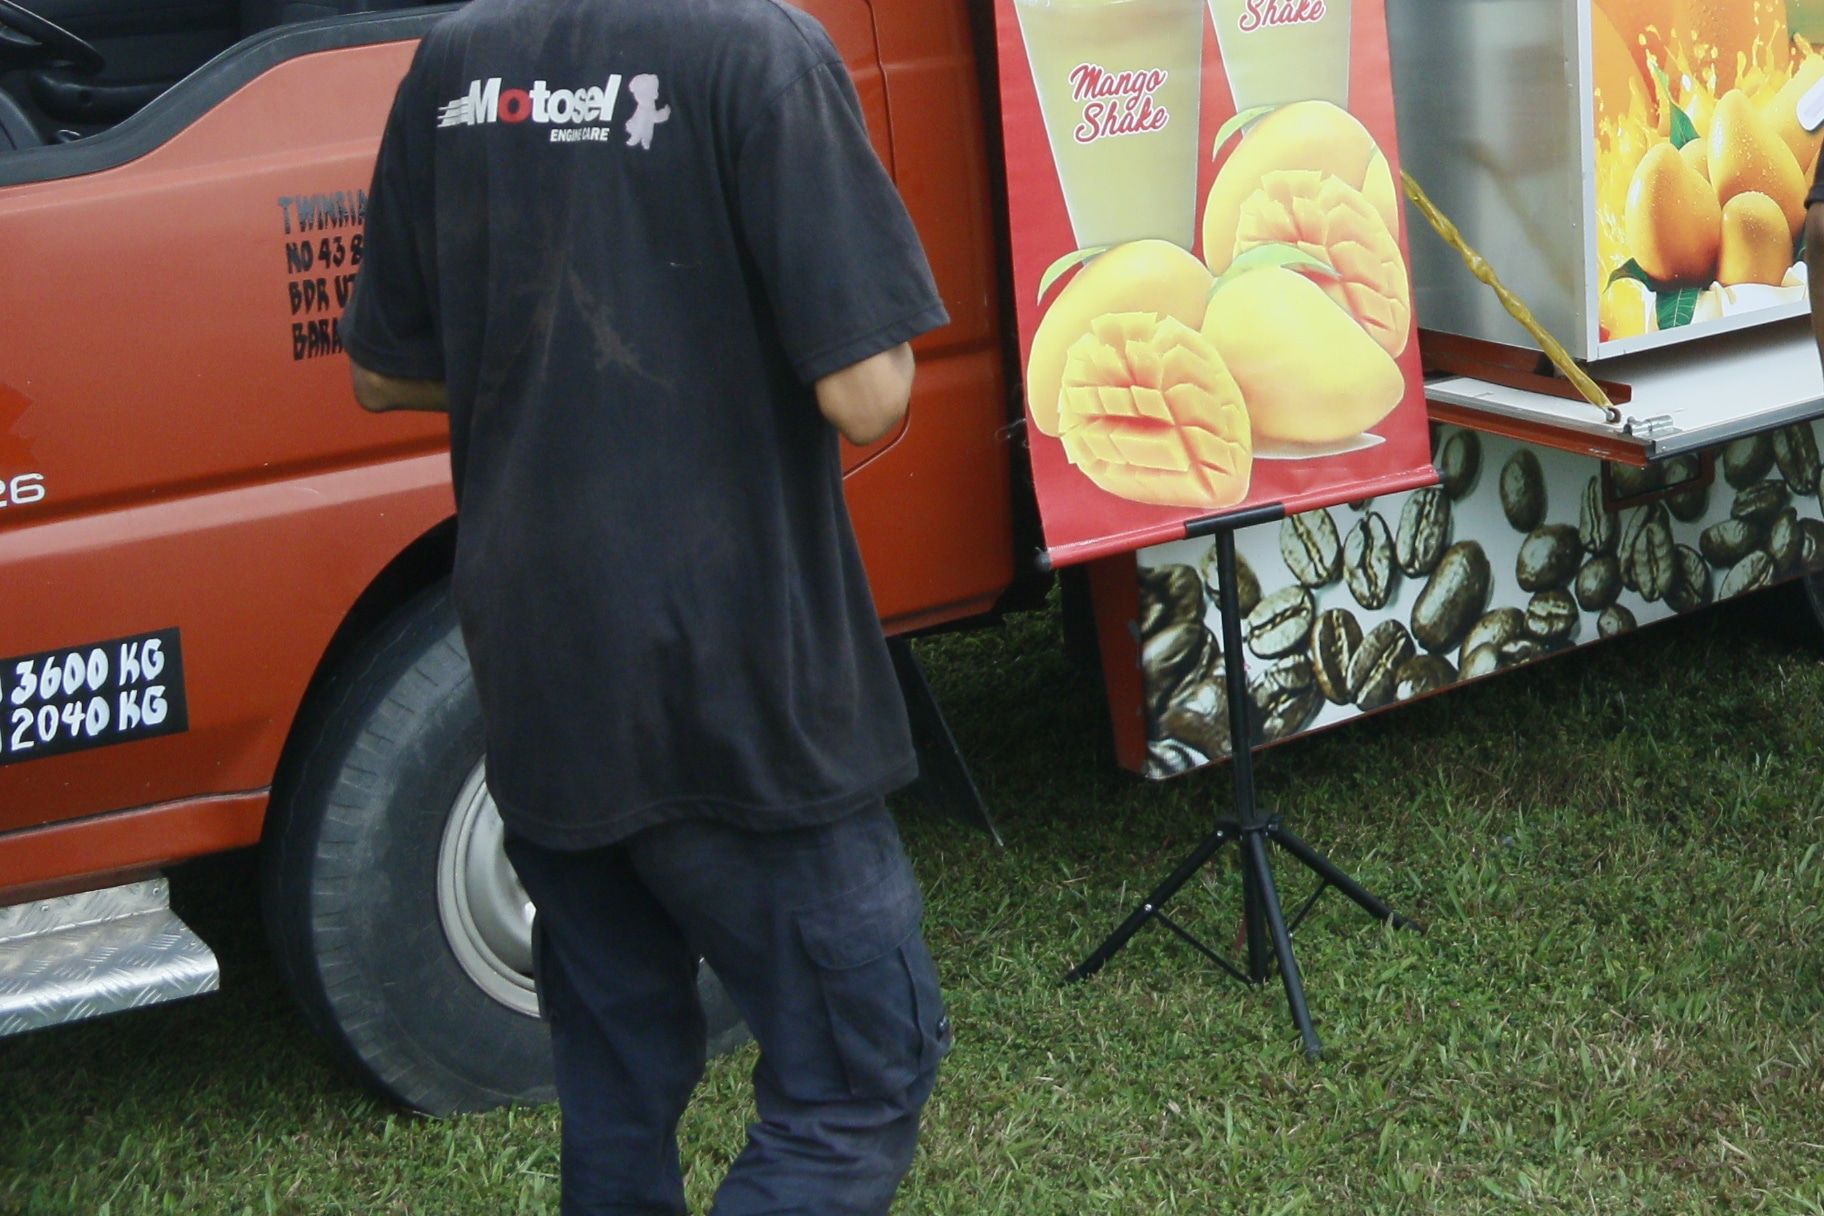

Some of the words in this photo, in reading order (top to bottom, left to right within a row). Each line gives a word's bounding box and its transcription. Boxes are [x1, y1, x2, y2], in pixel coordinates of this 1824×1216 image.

[460, 73, 622, 127] Motosel
[1069, 64, 1168, 110] Mango
[1074, 99, 1170, 144] Shake
[286, 240, 314, 274] NO
[318, 236, 346, 269] 43
[0, 472, 46, 508] 6
[11, 647, 109, 705] 3600
[119, 638, 165, 685] KG
[11, 695, 110, 752] 2040
[119, 685, 168, 731] KG
